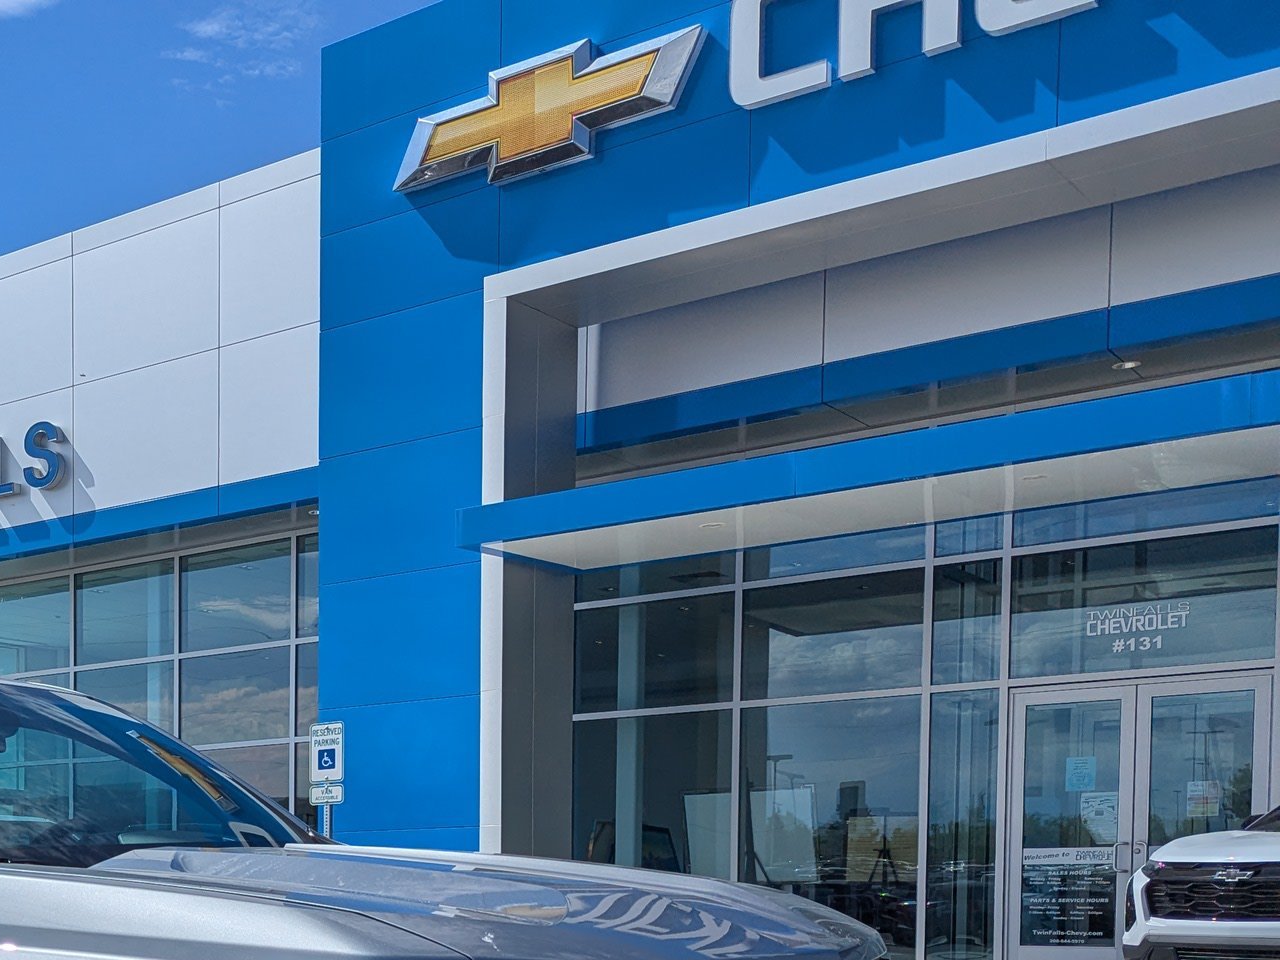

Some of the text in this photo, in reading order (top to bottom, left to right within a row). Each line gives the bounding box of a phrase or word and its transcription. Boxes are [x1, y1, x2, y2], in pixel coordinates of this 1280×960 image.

[1086, 611, 1190, 637] CHEVROLET
[1111, 635, 1163, 653] #131
[312, 727, 342, 738] RESERVED
[313, 737, 340, 748] PARKING
[1024, 852, 1060, 861] Welcome
